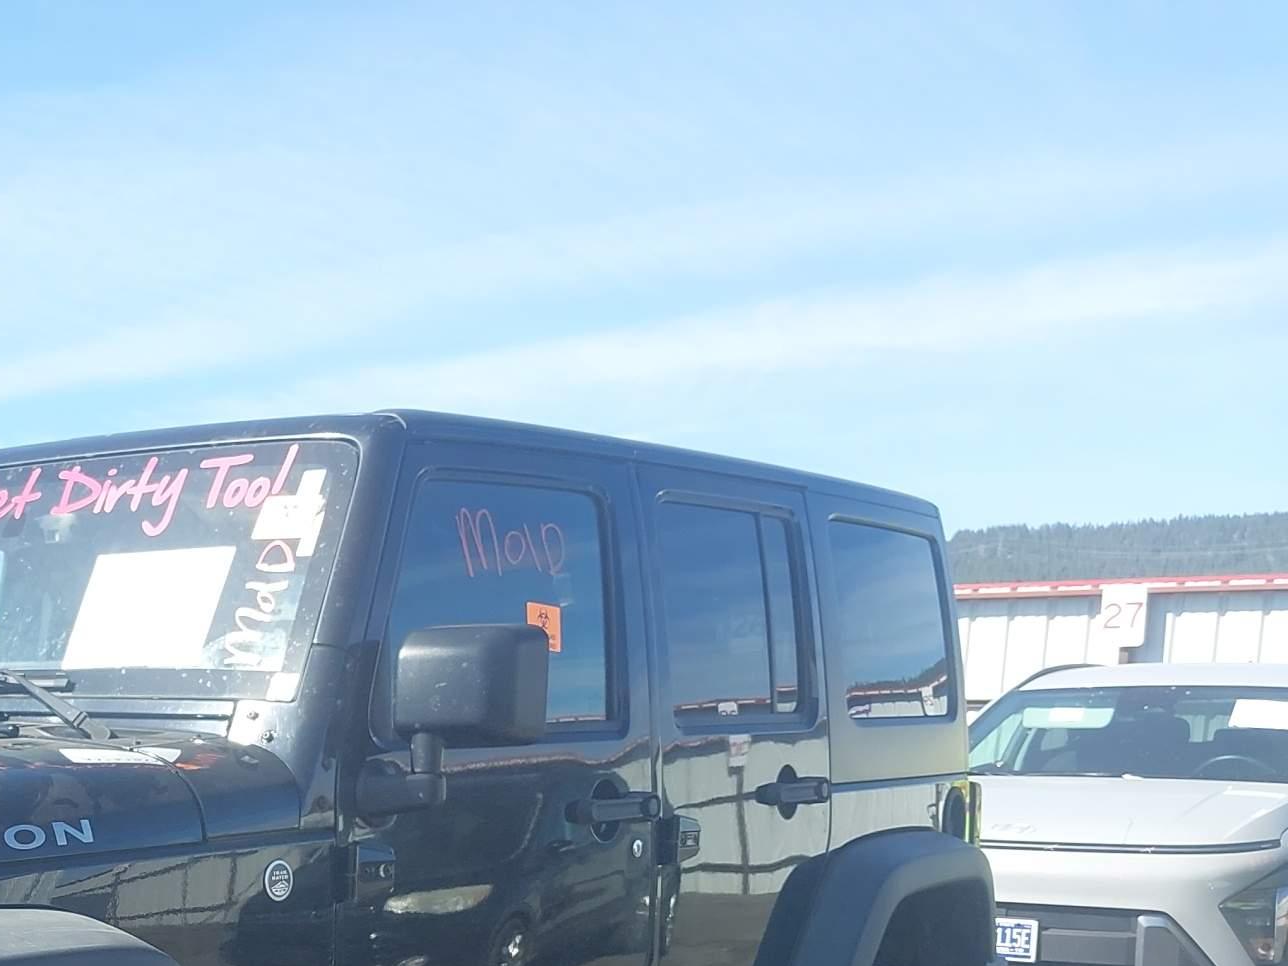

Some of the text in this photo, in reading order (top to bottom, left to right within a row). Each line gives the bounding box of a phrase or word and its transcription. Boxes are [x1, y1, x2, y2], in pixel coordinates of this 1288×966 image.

[50, 456, 189, 537] Dirty
[199, 443, 300, 510] Too!
[1103, 602, 1144, 629] 27
